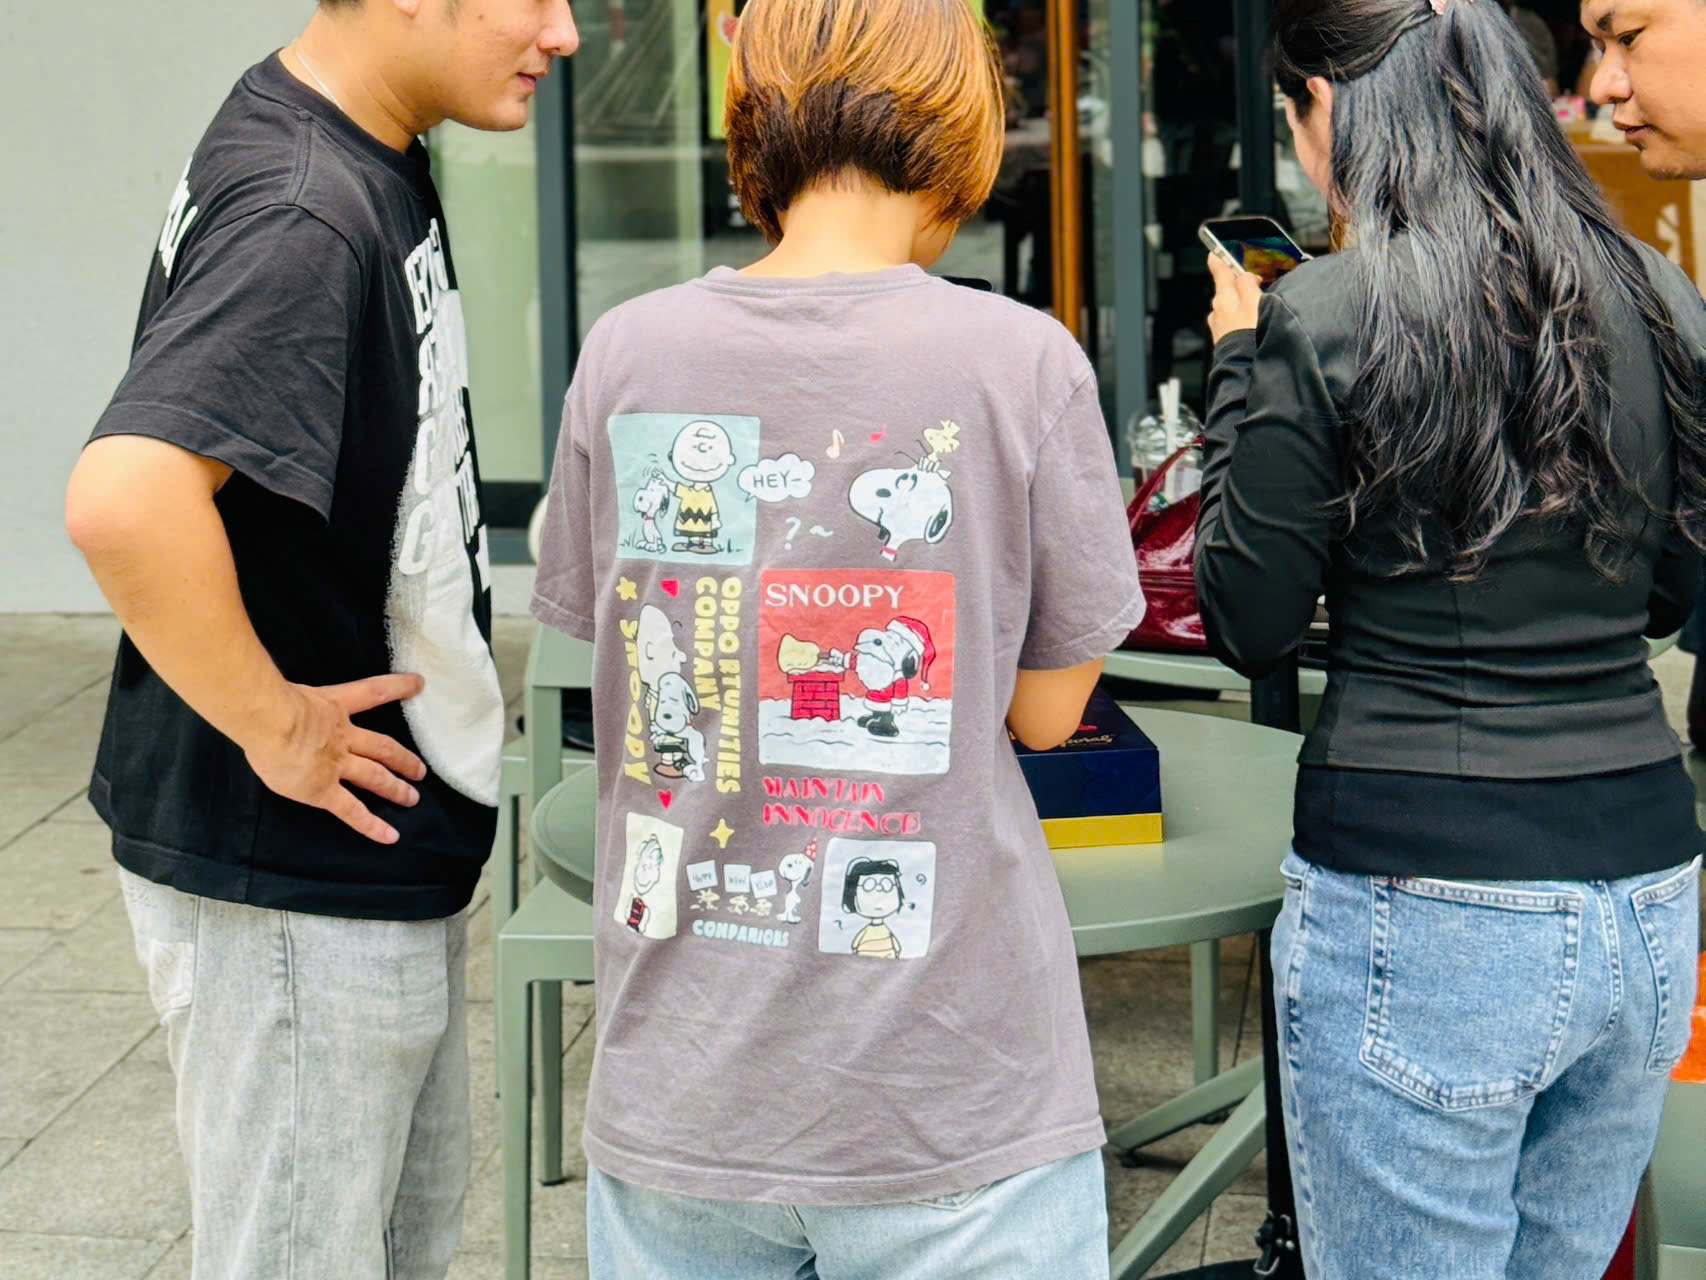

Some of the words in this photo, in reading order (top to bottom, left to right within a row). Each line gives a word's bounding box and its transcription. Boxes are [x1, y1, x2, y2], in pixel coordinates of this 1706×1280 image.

[764, 583, 905, 609] SNOOPY
[693, 576, 723, 712] COMPANY
[762, 776, 886, 804] MAINTAIN
[691, 919, 791, 948] COMPANIONS
